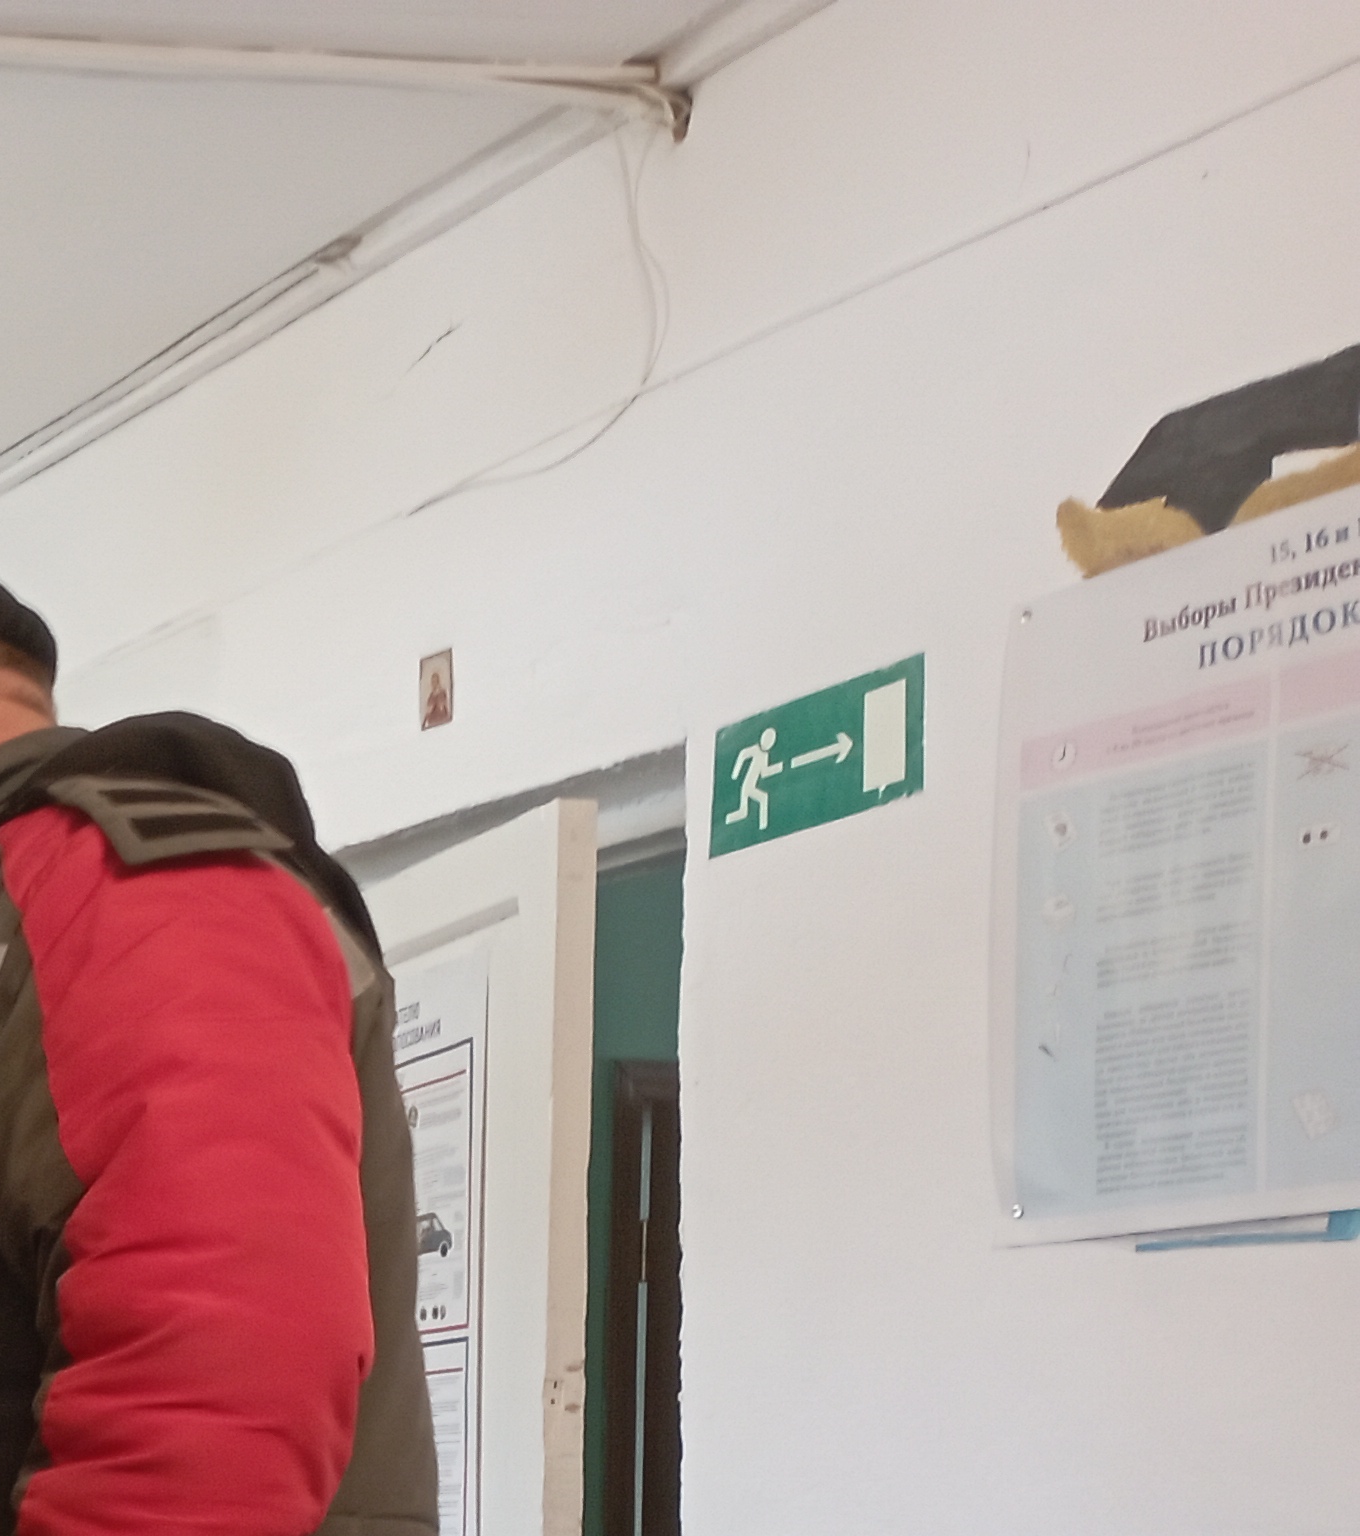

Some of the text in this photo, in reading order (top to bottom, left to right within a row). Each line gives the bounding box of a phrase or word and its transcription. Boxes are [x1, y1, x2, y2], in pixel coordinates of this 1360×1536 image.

[1305, 526, 1329, 553] 16
[1143, 597, 1237, 642] Выборы
[1198, 600, 1360, 670] ПОРЯДОК
